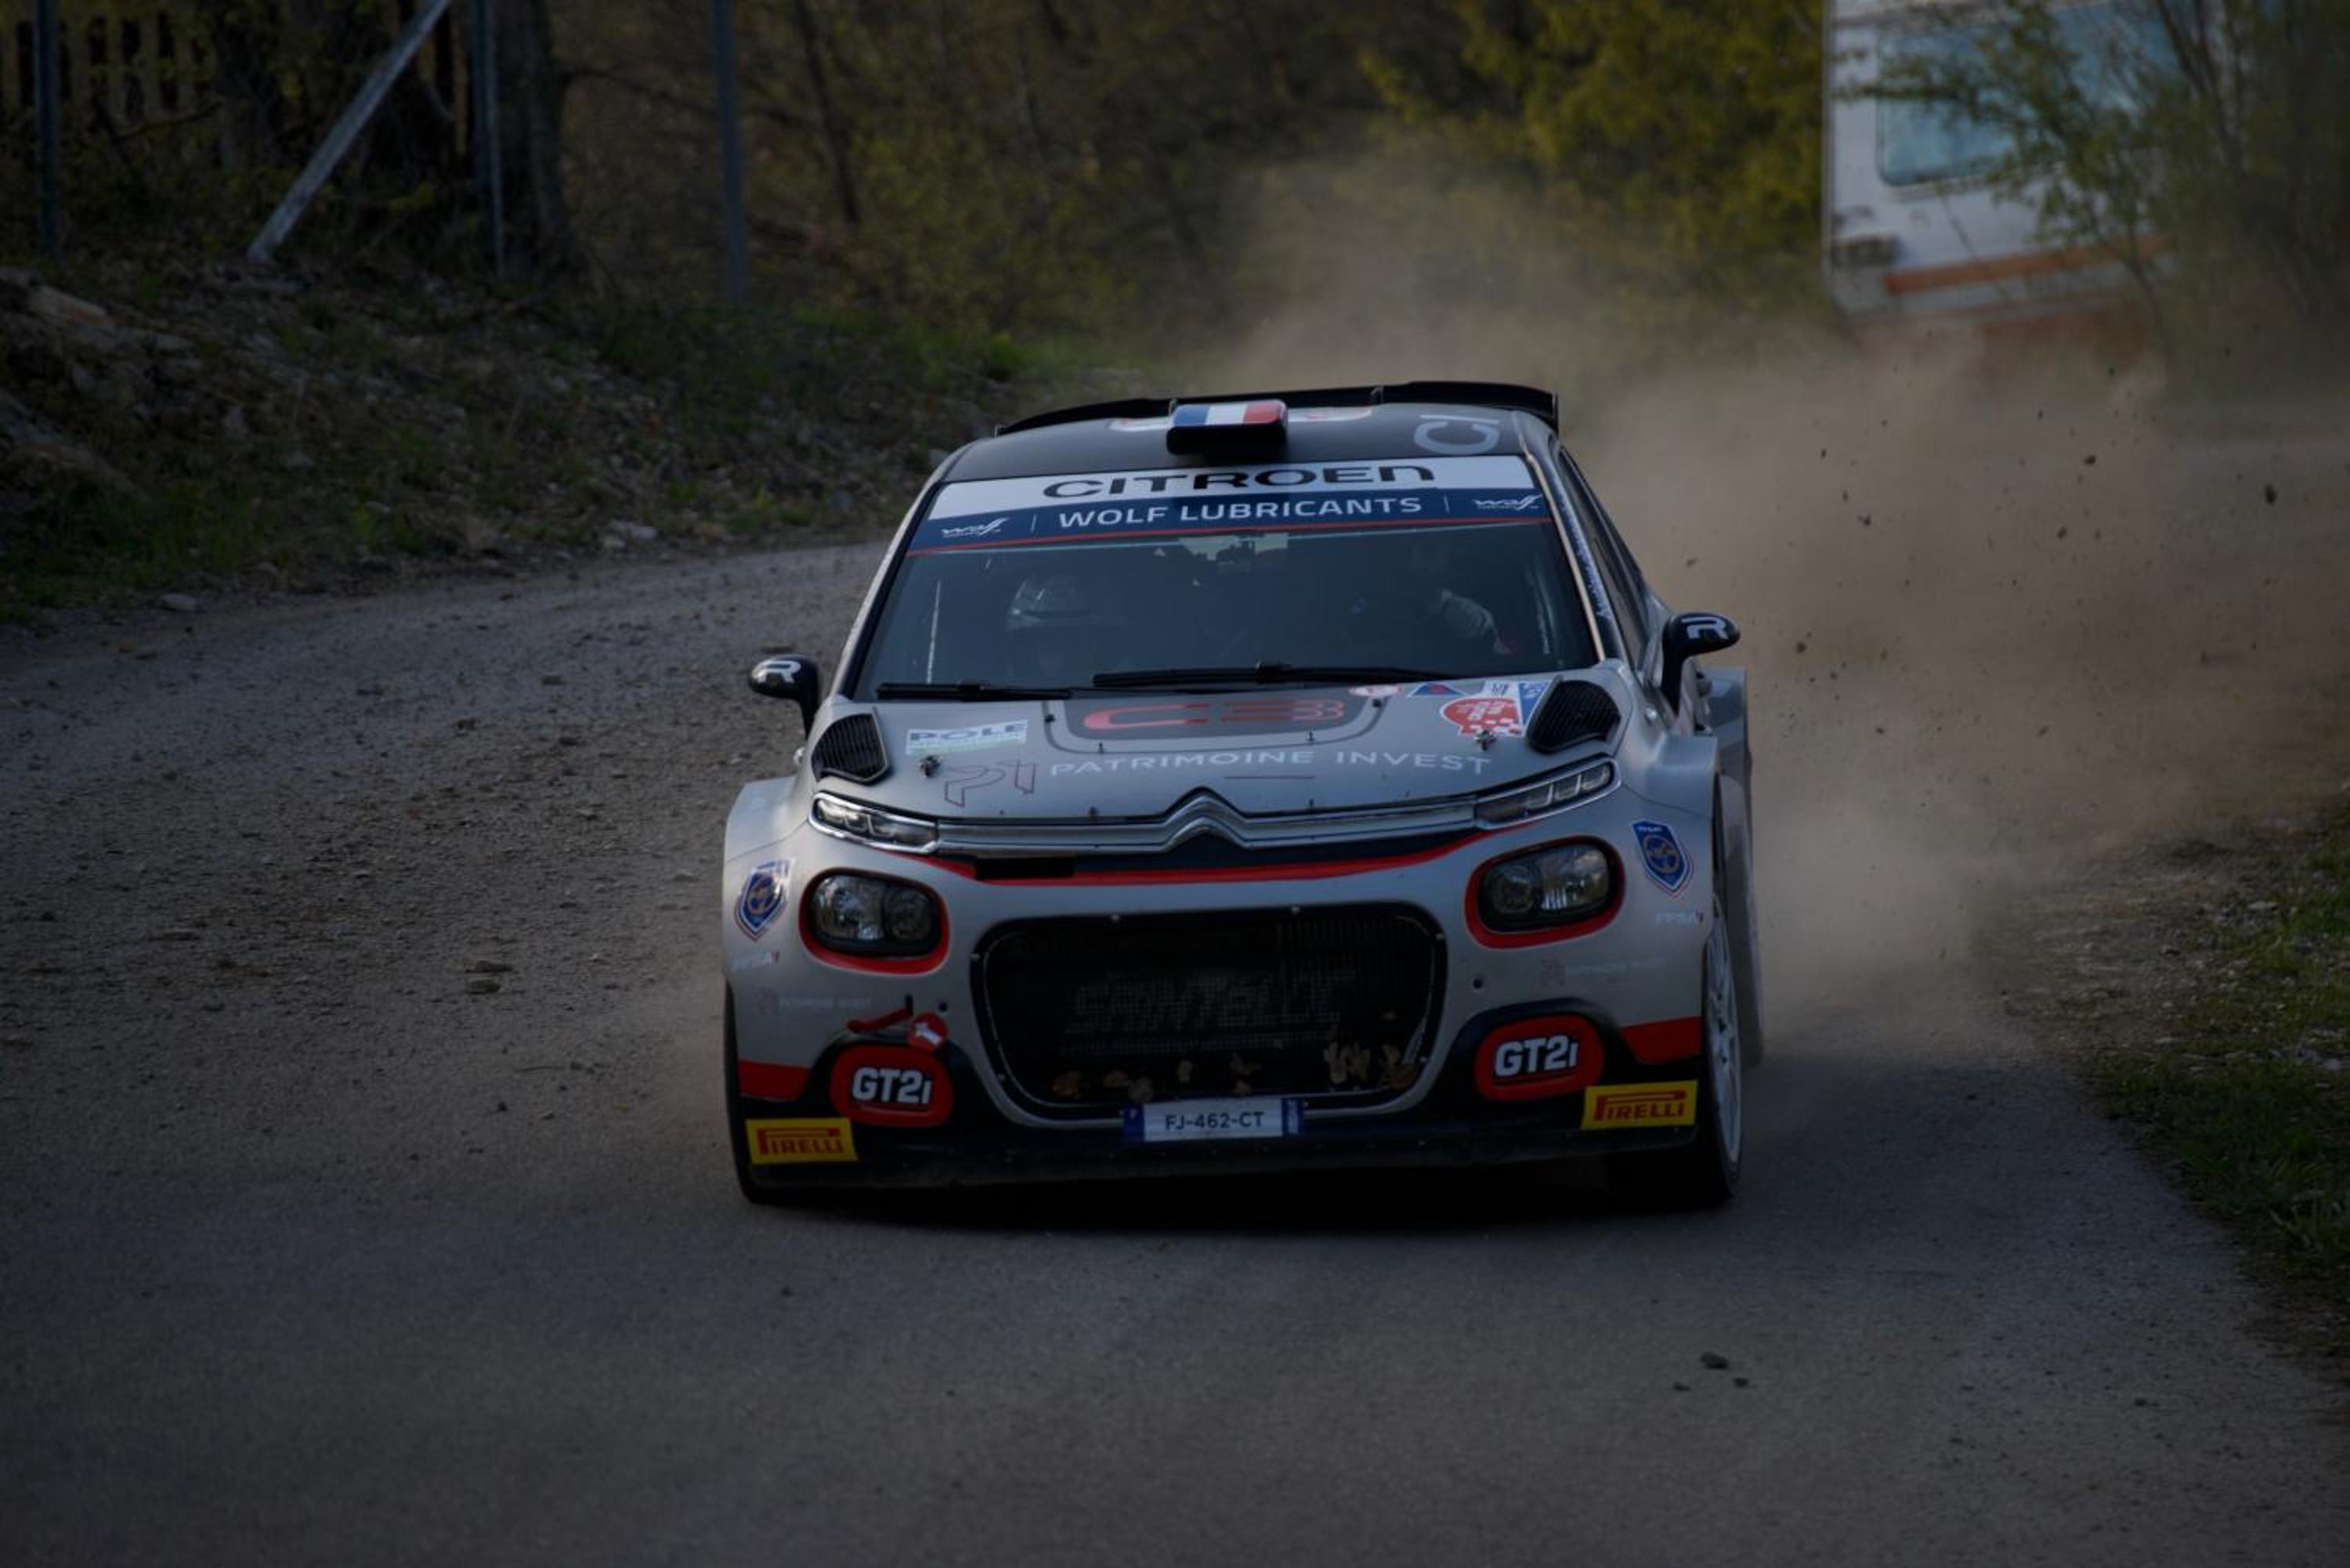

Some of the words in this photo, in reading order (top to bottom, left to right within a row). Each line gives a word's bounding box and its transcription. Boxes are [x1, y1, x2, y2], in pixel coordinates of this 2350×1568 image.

[1058, 506, 1170, 529] WOLF
[1180, 497, 1423, 522] LUBRICANTS
[1083, 699, 1346, 731] C3
[1052, 750, 1315, 777] PATRIMOINE
[1336, 750, 1492, 775] INVEST
[1593, 1089, 1687, 1122] PIRELLI
[1164, 1111, 1265, 1131] FJ-462-CT
[757, 1126, 847, 1155] PIRELLI
